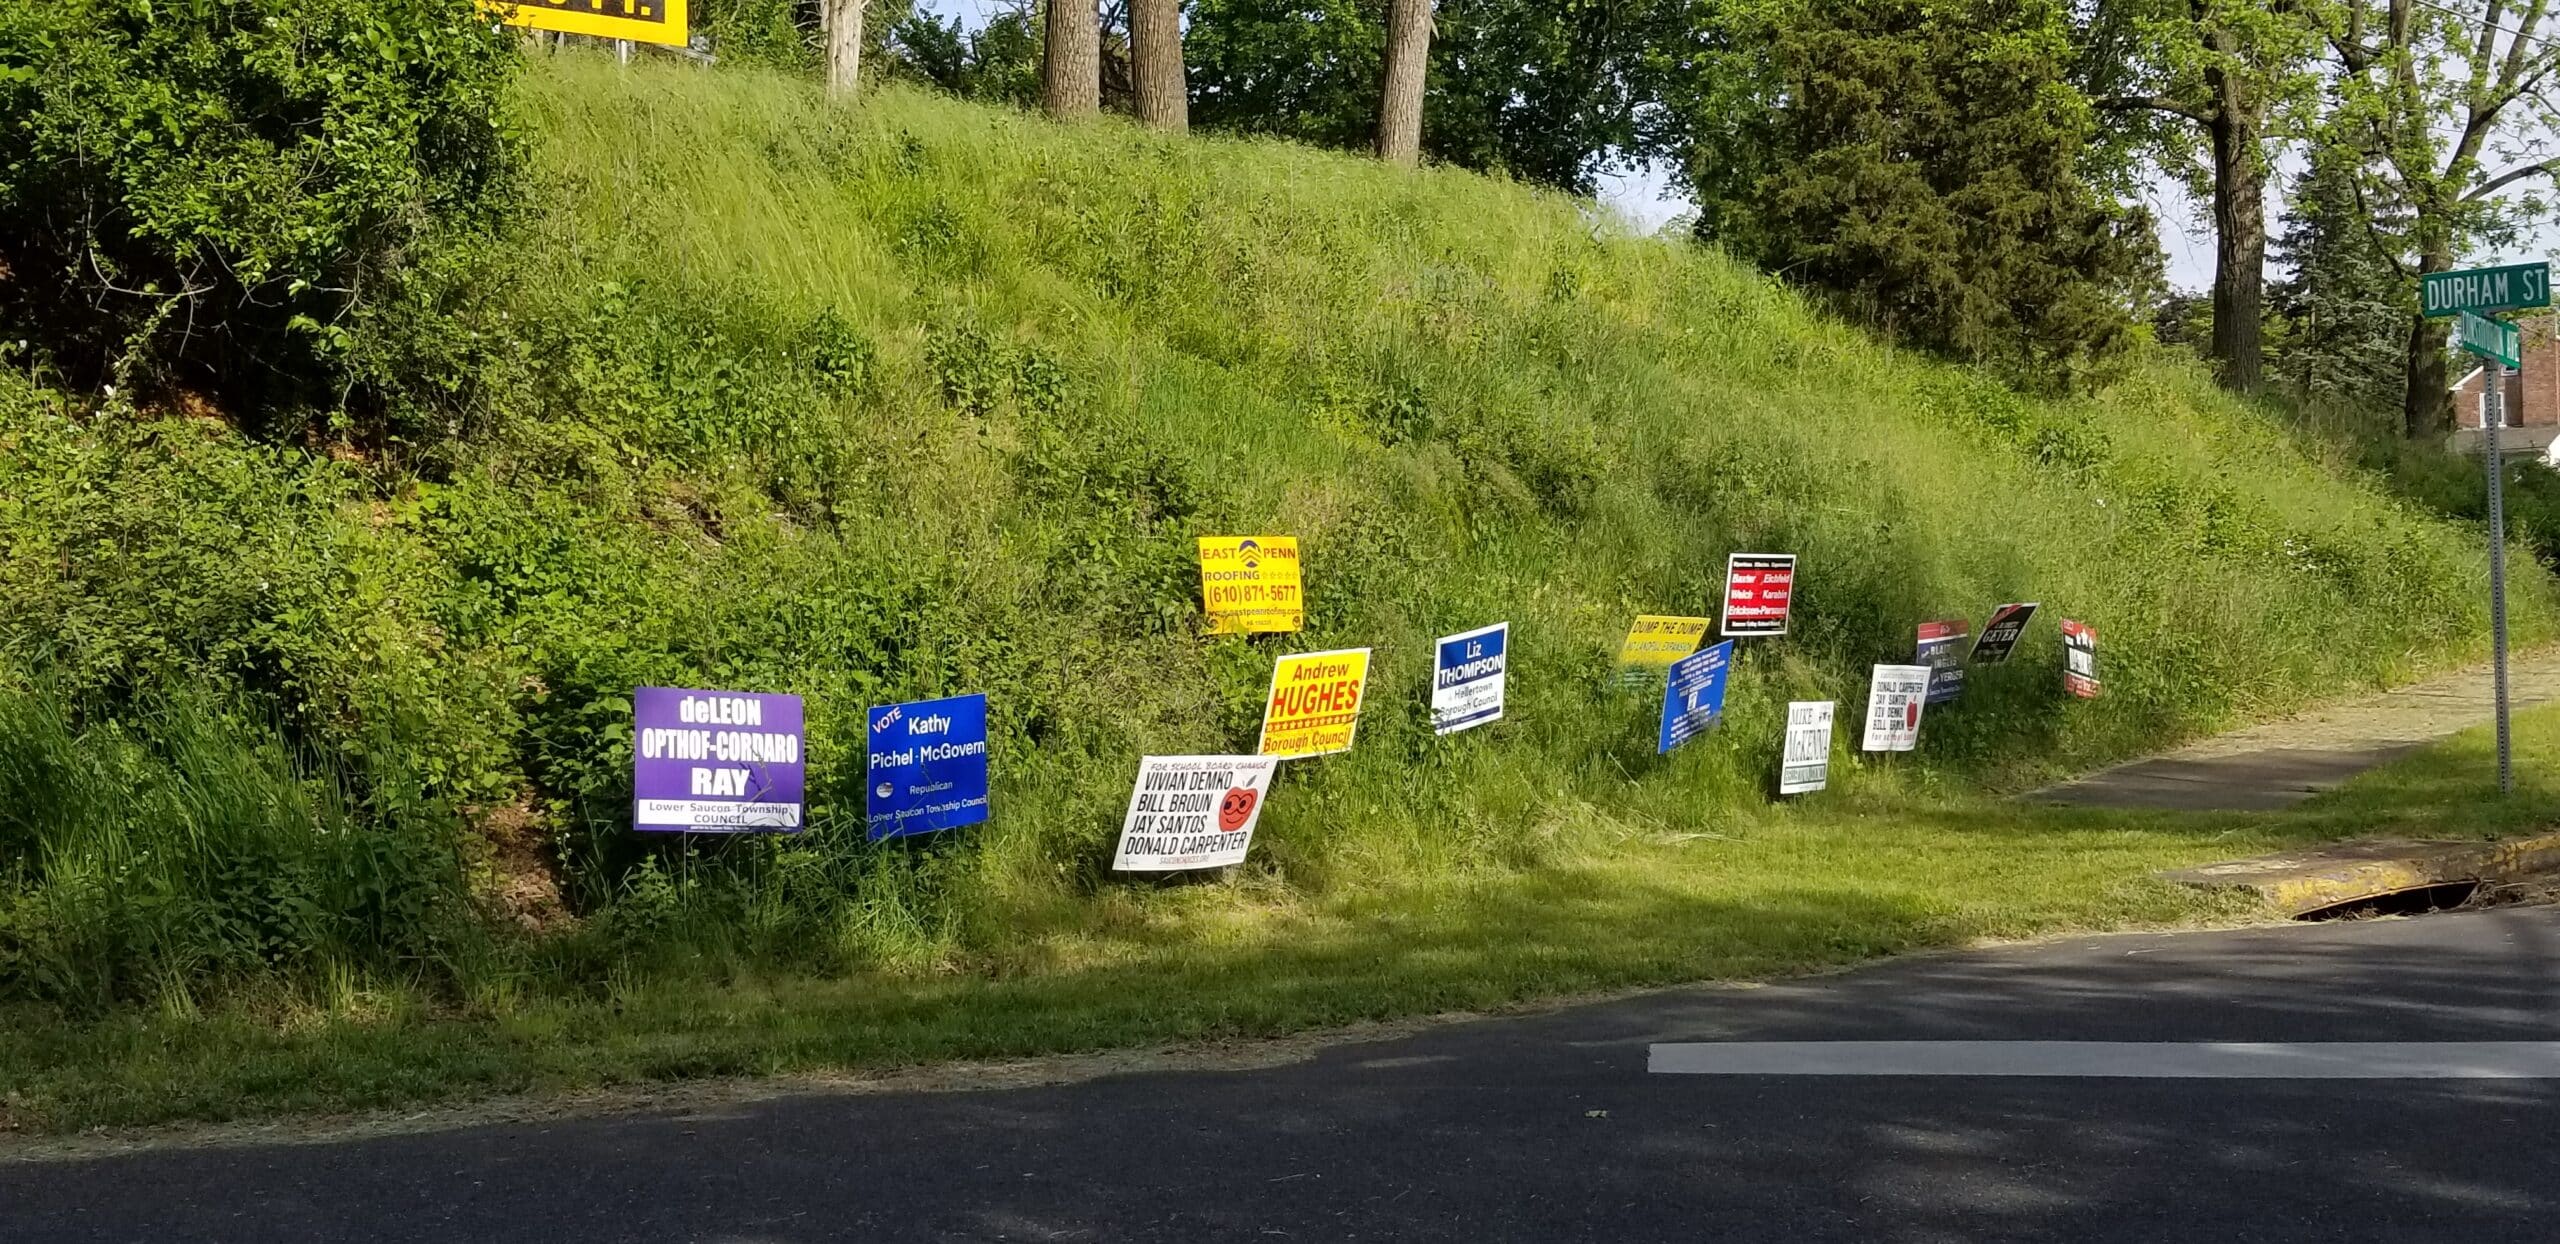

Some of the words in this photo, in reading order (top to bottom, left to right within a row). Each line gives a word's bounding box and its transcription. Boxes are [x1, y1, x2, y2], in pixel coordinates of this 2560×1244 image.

[2427, 271, 2509, 310] DURHAM
[2522, 268, 2545, 301] ST
[1202, 547, 1237, 560] EAST
[1263, 547, 1296, 559] PENN
[1205, 571, 1260, 581] ROOFING
[1632, 621, 1659, 633] DUMP
[1659, 622, 1677, 634] THE
[1676, 623, 1705, 635] DUMP!
[1466, 640, 1482, 659] Liz
[1292, 662, 1350, 681] Andrew
[1440, 654, 1503, 685] THOMPSON
[1454, 682, 1493, 699] Hellertown
[1876, 681, 1897, 693] DONALD
[1899, 681, 1924, 693] CARPENTER
[1270, 680, 1359, 718] HUGHES
[1440, 702, 1472, 717] Borough
[1473, 691, 1498, 708] Council
[1876, 694, 1886, 705] JAY
[1888, 694, 1908, 706] SANTOS
[680, 696, 762, 726] deLEON
[872, 706, 903, 734] VOTE
[1789, 707, 1814, 726] MIKE
[1874, 706, 1885, 718] VIV
[1887, 706, 1904, 718] DEMKO
[908, 713, 951, 736] Kathy
[1872, 719, 1887, 731] BILL
[641, 728, 799, 764] OPTHOF-CORDARO
[1263, 734, 1309, 753] Borough
[1312, 727, 1352, 747] Council
[1785, 728, 1829, 763] McKENNA
[1151, 762, 1169, 771] FOR
[1170, 761, 1202, 771] SCHOOL
[1205, 761, 1233, 770] BOARD
[691, 767, 750, 797] RAY
[909, 780, 954, 796] Republican
[1145, 771, 1193, 791] VIVIAN
[1189, 771, 1234, 791] DEMKO
[649, 801, 685, 812] Lower
[690, 802, 731, 813] Saucon
[736, 803, 789, 815] Township
[868, 812, 894, 824] Lower
[895, 807, 925, 820] Saucon
[926, 799, 961, 815] Township
[961, 794, 988, 808] Council
[1137, 793, 1165, 813] BILL
[1168, 794, 1214, 813] BROUN
[694, 814, 748, 825] COUNCIL
[1130, 815, 1157, 834] JAY
[1156, 815, 1208, 834] SANTOS
[1125, 836, 1179, 855] DONALD
[1180, 831, 1247, 854] CARPENTER
